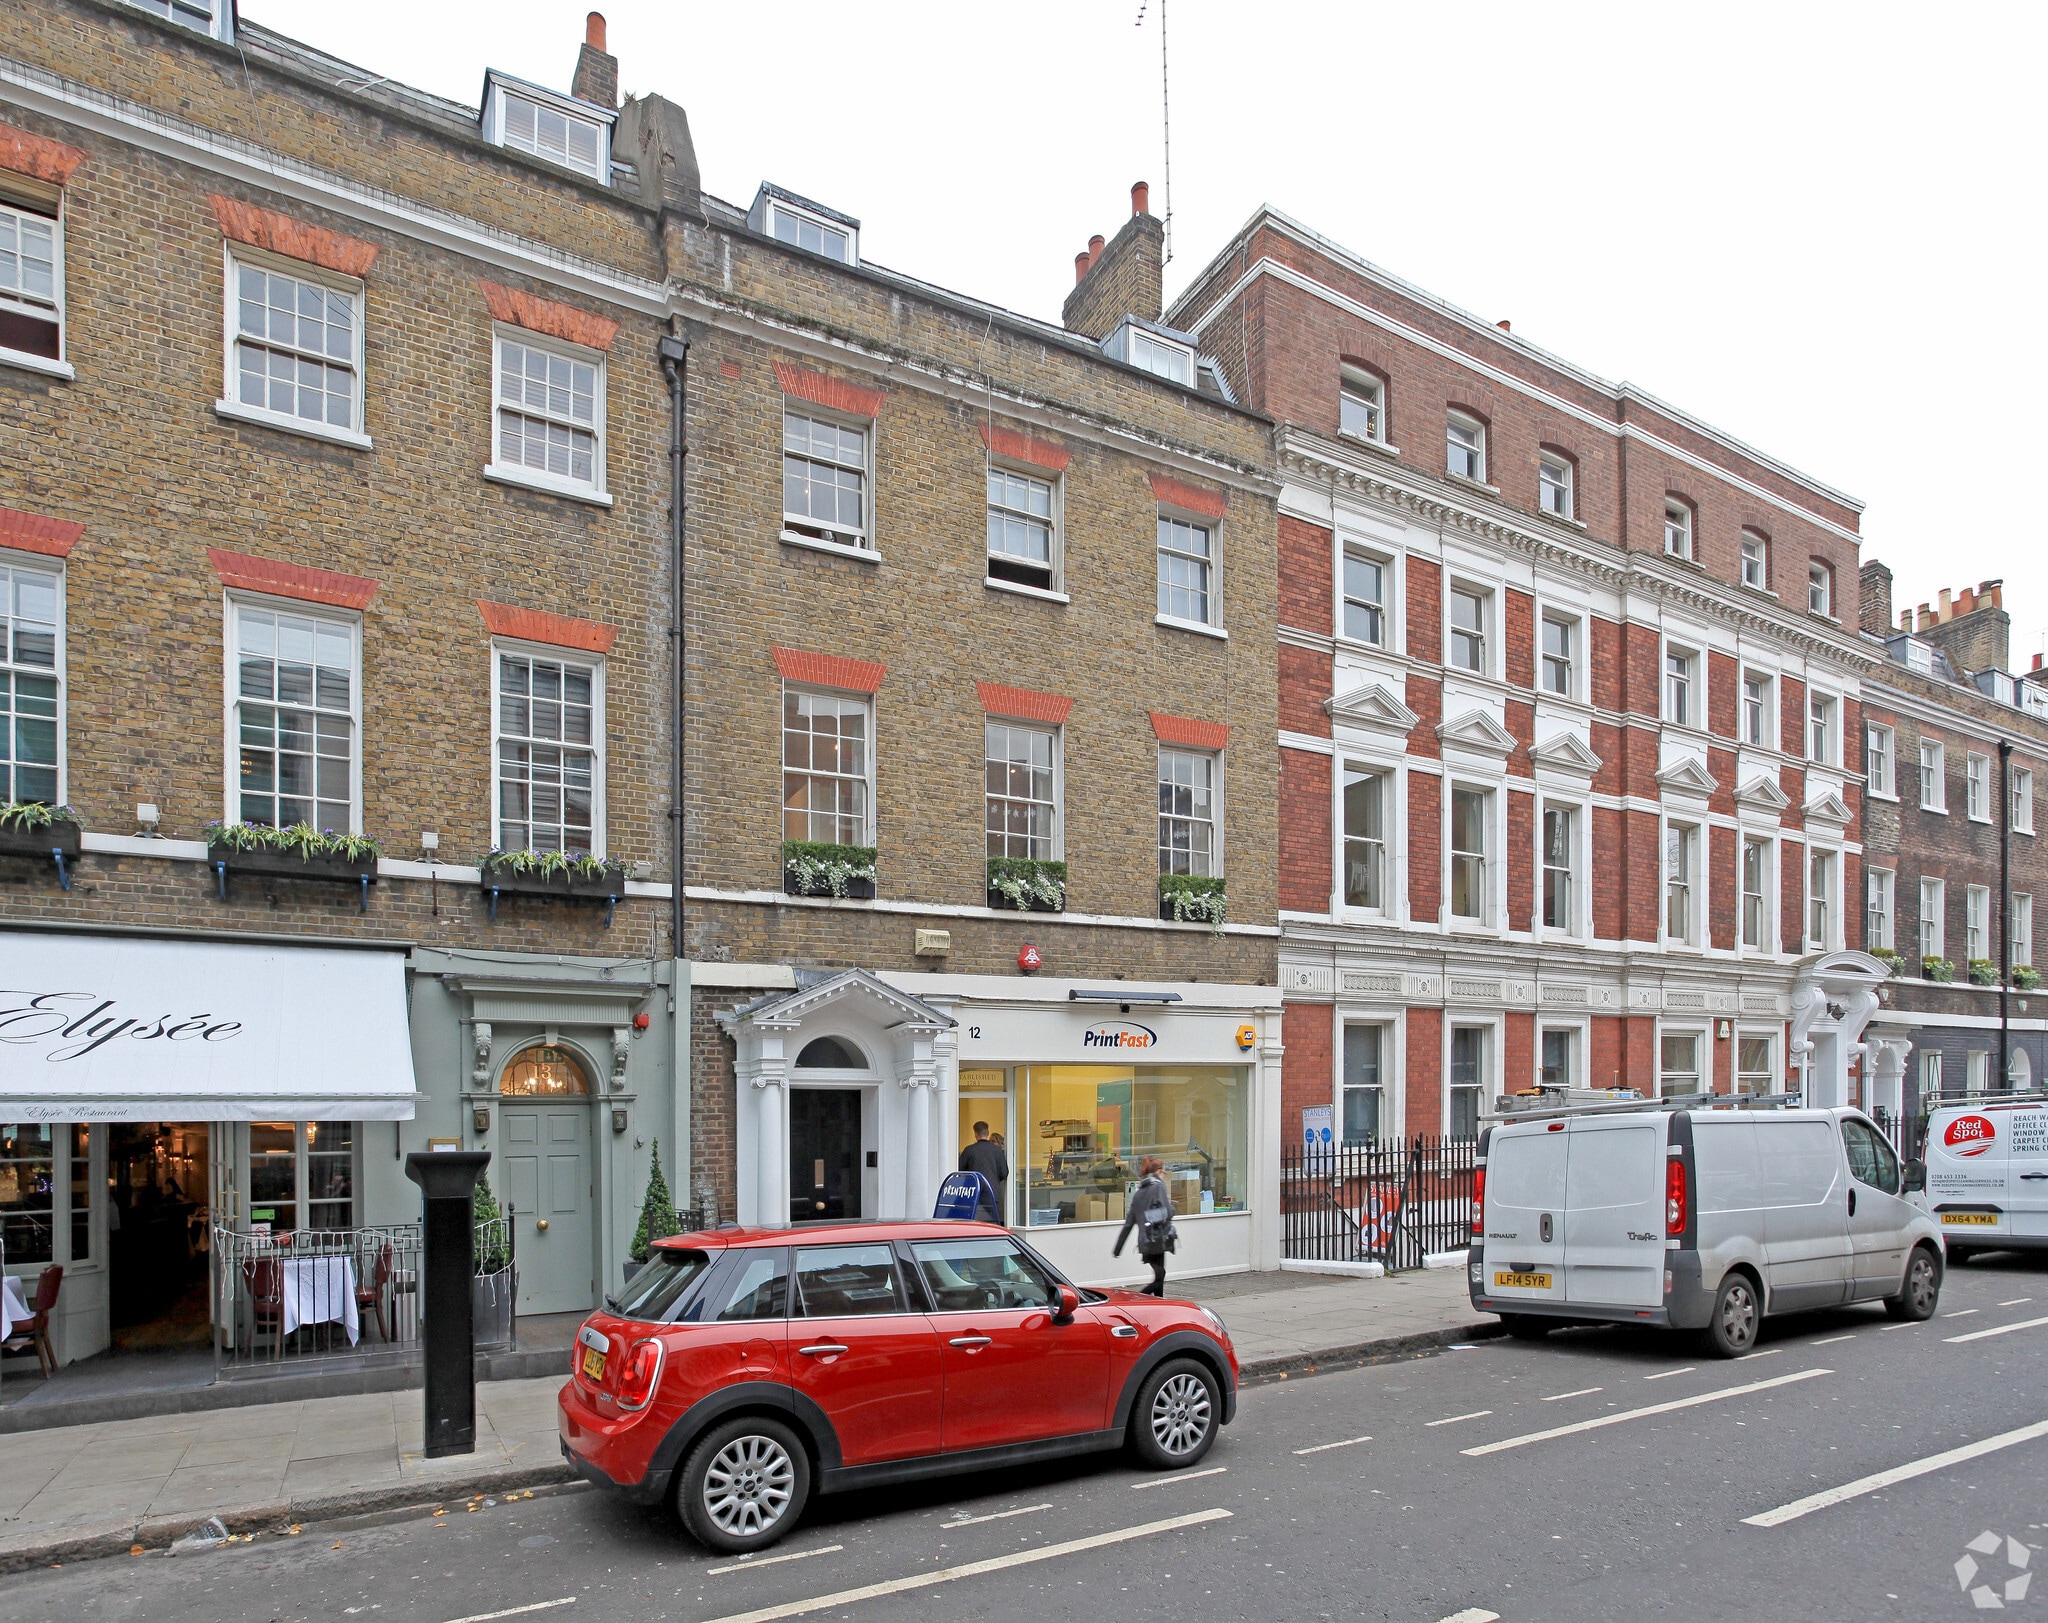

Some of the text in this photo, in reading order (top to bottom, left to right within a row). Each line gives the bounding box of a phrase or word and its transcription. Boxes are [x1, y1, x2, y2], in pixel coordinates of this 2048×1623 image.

[968, 1026, 981, 1039] 12
[1084, 1029, 1149, 1048] PrintFast
[532, 1066, 552, 1079] 13
[25, 1106, 128, 1121] Elysée Restaurant
[1956, 1120, 1981, 1130] Red
[1953, 1129, 1984, 1140] Spot
[2013, 1137, 2039, 1145] CARPET
[1945, 1215, 1971, 1223] DX64
[1626, 1232, 1658, 1241] Trafic
[1500, 1274, 1545, 1287] LF14 SYR
